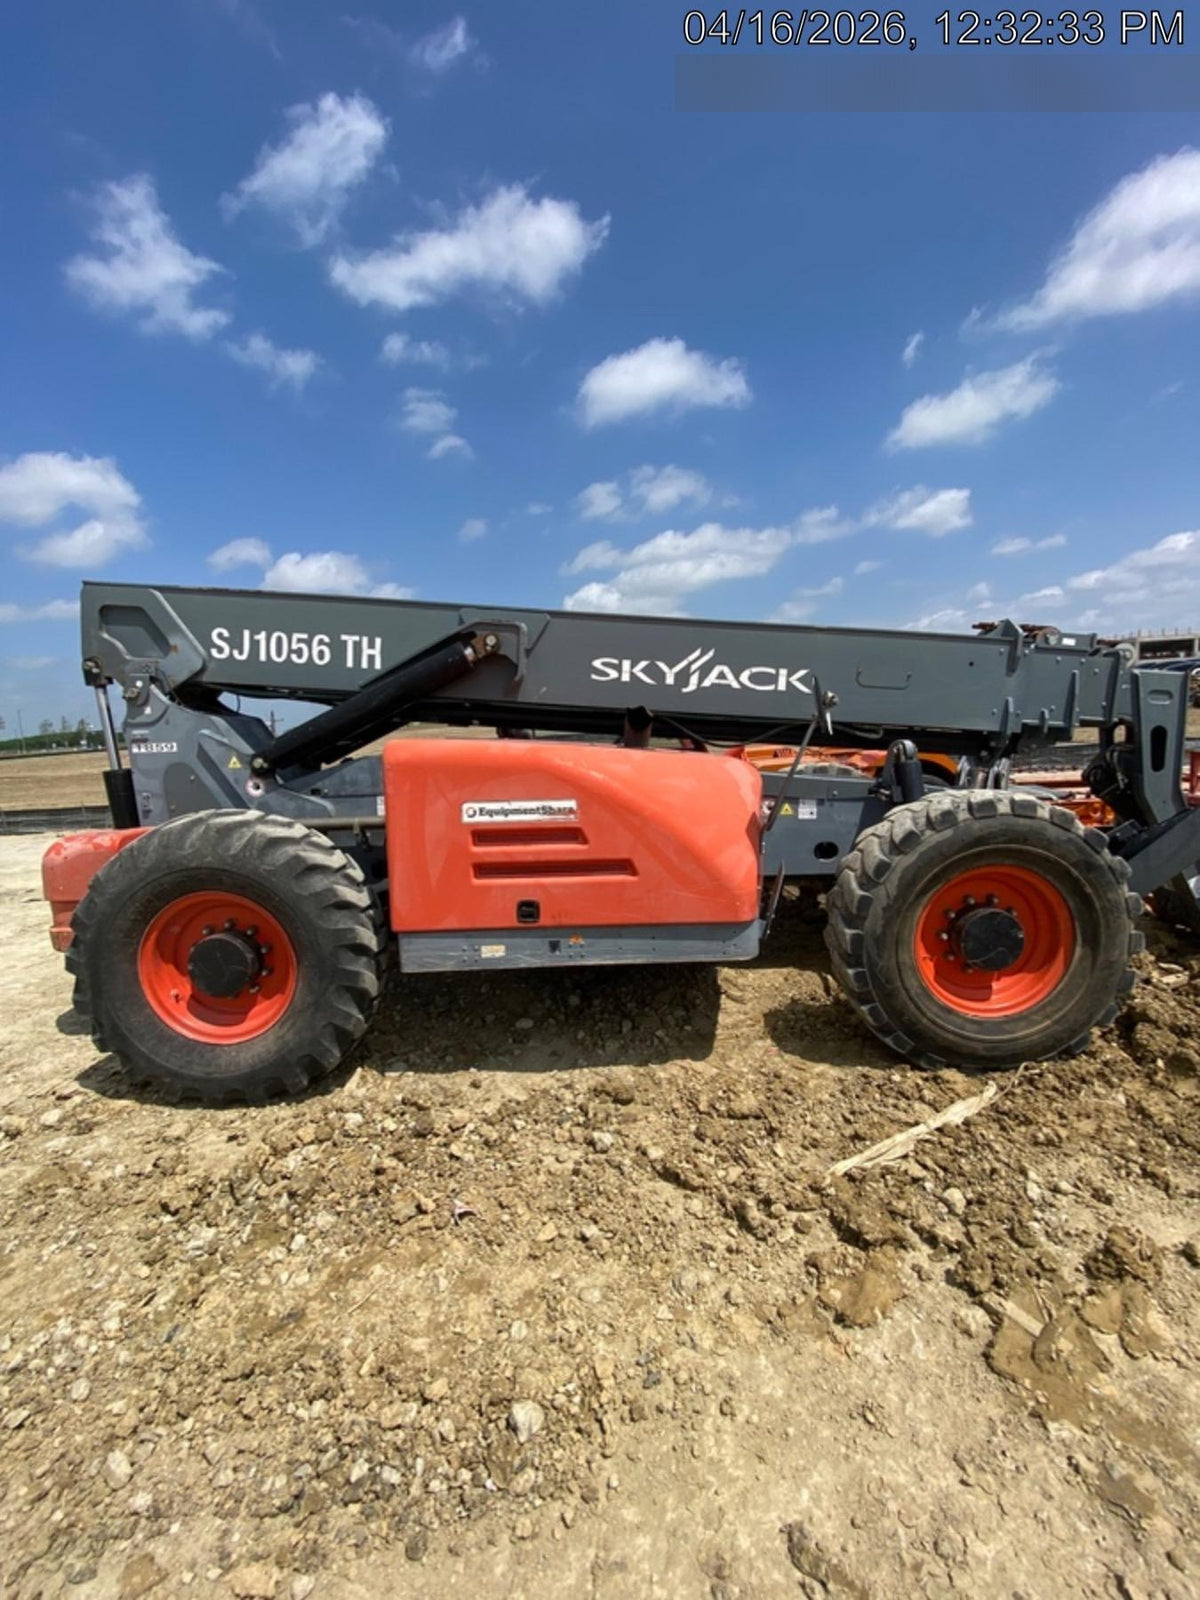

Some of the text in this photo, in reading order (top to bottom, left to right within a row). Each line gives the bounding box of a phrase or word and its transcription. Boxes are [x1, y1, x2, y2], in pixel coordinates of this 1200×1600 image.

[210, 627, 382, 670] SJ1056 TH
[590, 647, 813, 694] SKYJACK
[479, 805, 576, 818] EquipmentShare
